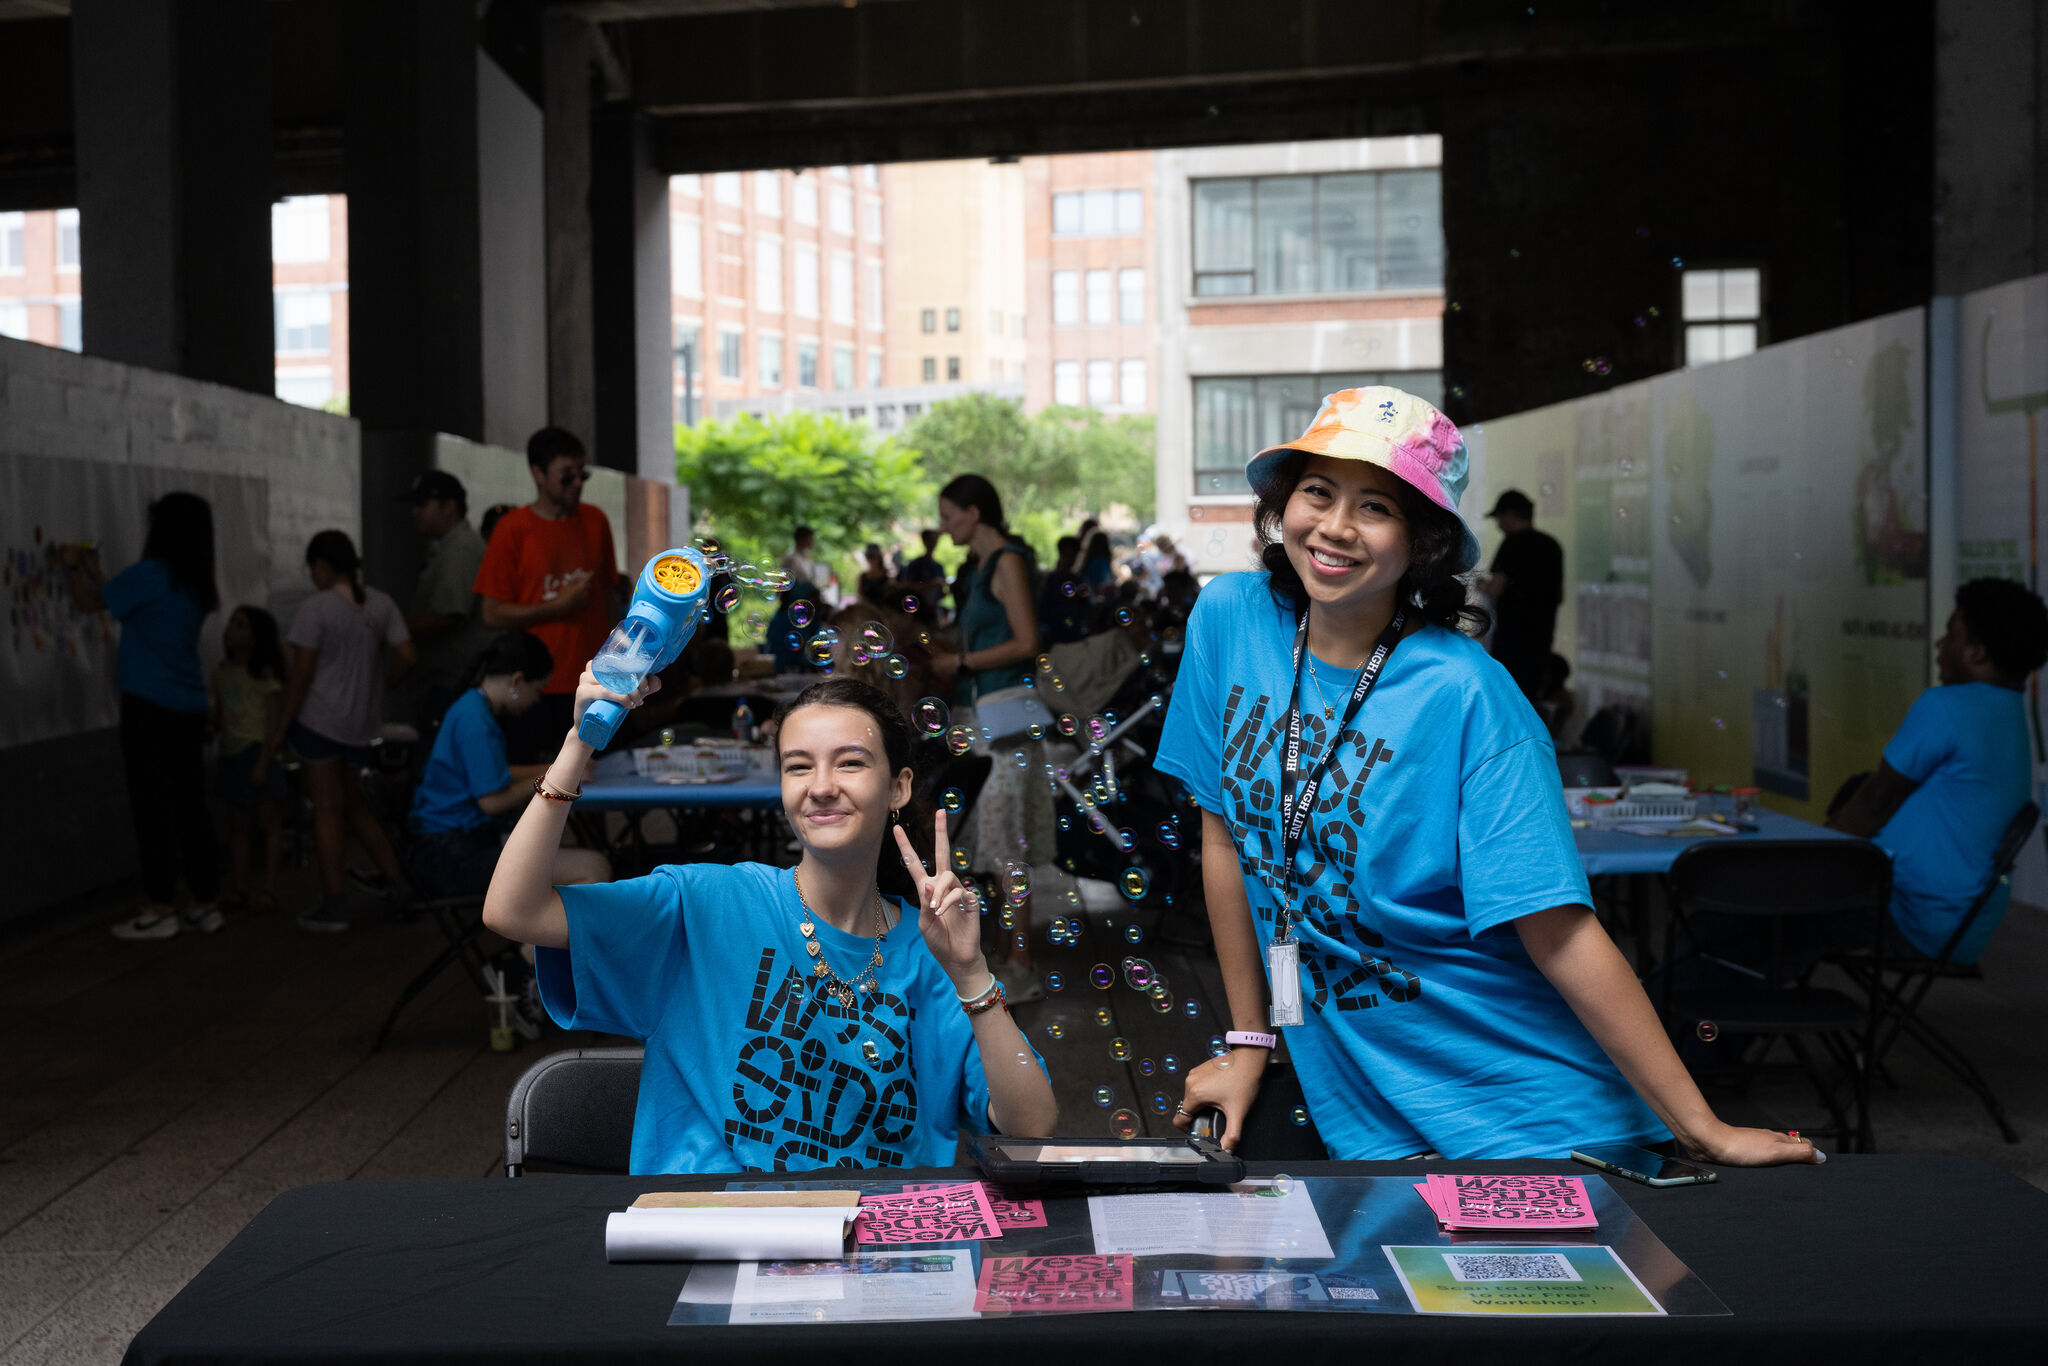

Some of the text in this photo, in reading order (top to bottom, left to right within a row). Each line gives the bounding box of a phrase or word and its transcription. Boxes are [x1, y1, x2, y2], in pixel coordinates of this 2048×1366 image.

[1353, 644, 1388, 702] HIGH LINE
[1286, 709, 1300, 772] HIGH LINE
[1289, 779, 1318, 840] HIGH LINE
[931, 1200, 975, 1210] July
[1460, 1208, 1586, 1219] 2025
[1462, 1203, 1506, 1212] July
